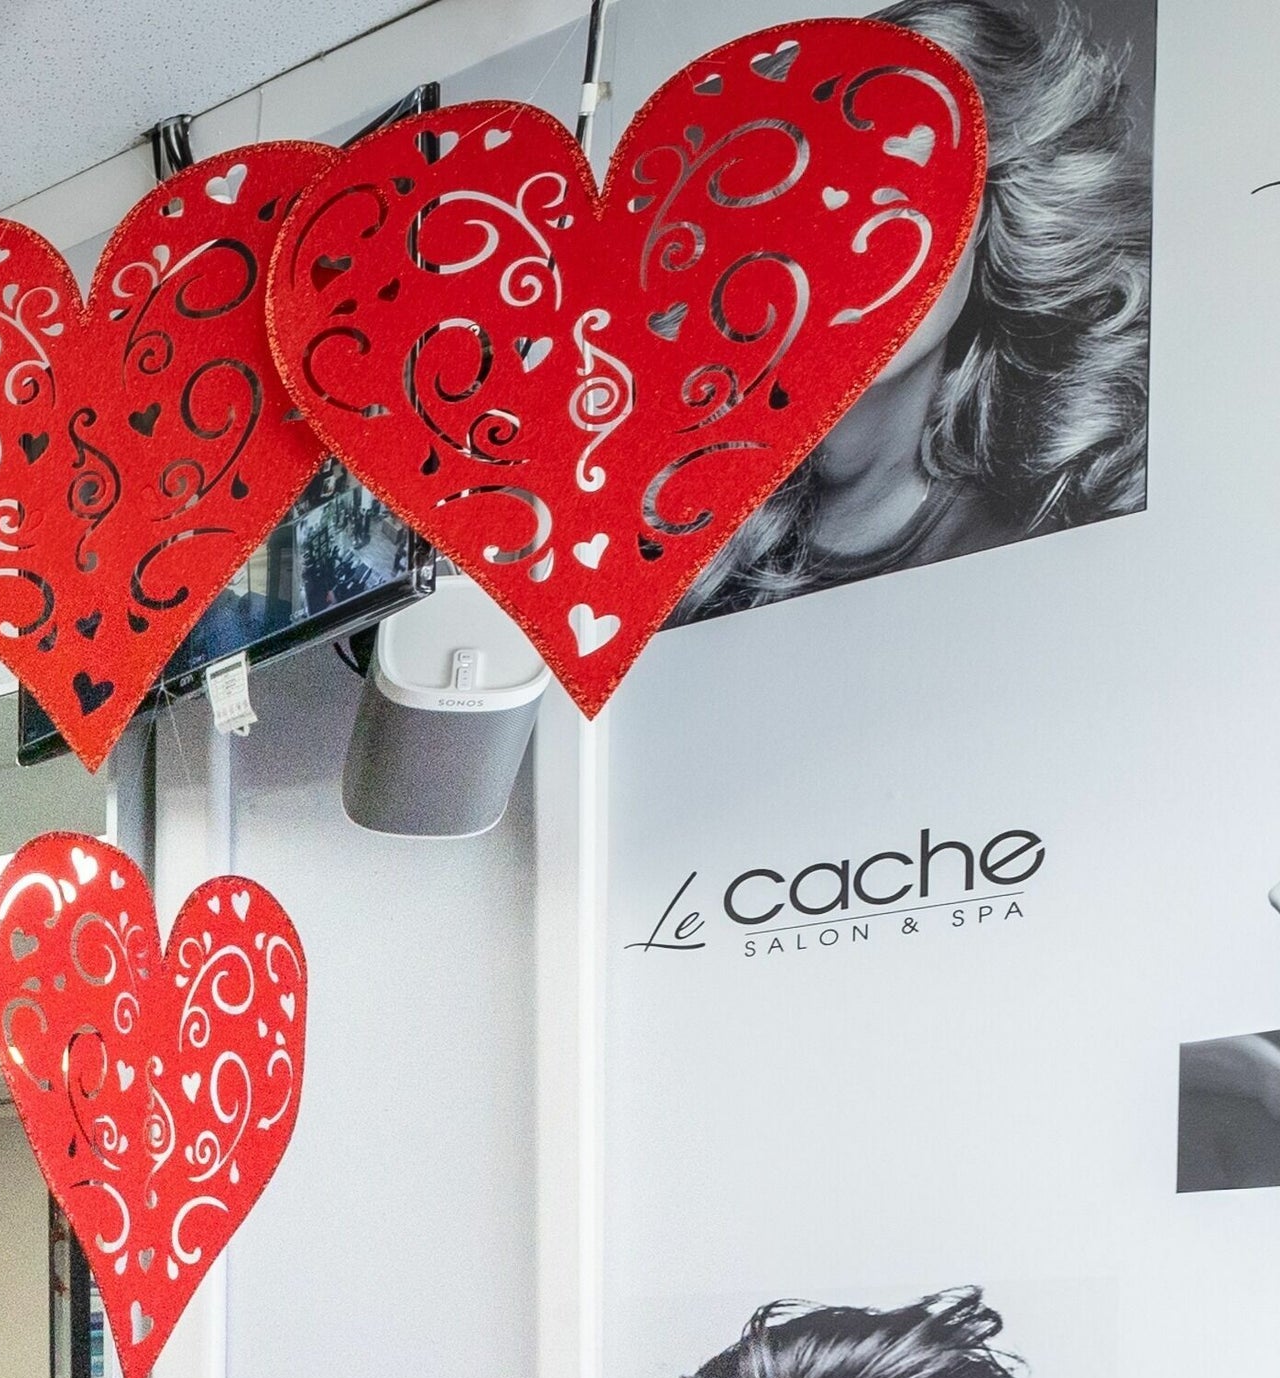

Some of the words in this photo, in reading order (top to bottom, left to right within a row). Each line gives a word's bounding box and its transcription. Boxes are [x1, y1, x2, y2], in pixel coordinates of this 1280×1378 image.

[438, 699, 484, 707] SONOS
[624, 871, 706, 952] Le
[723, 828, 1045, 925] cache
[744, 924, 869, 957] SALON
[901, 917, 919, 934] &
[952, 901, 1024, 927] SPA
